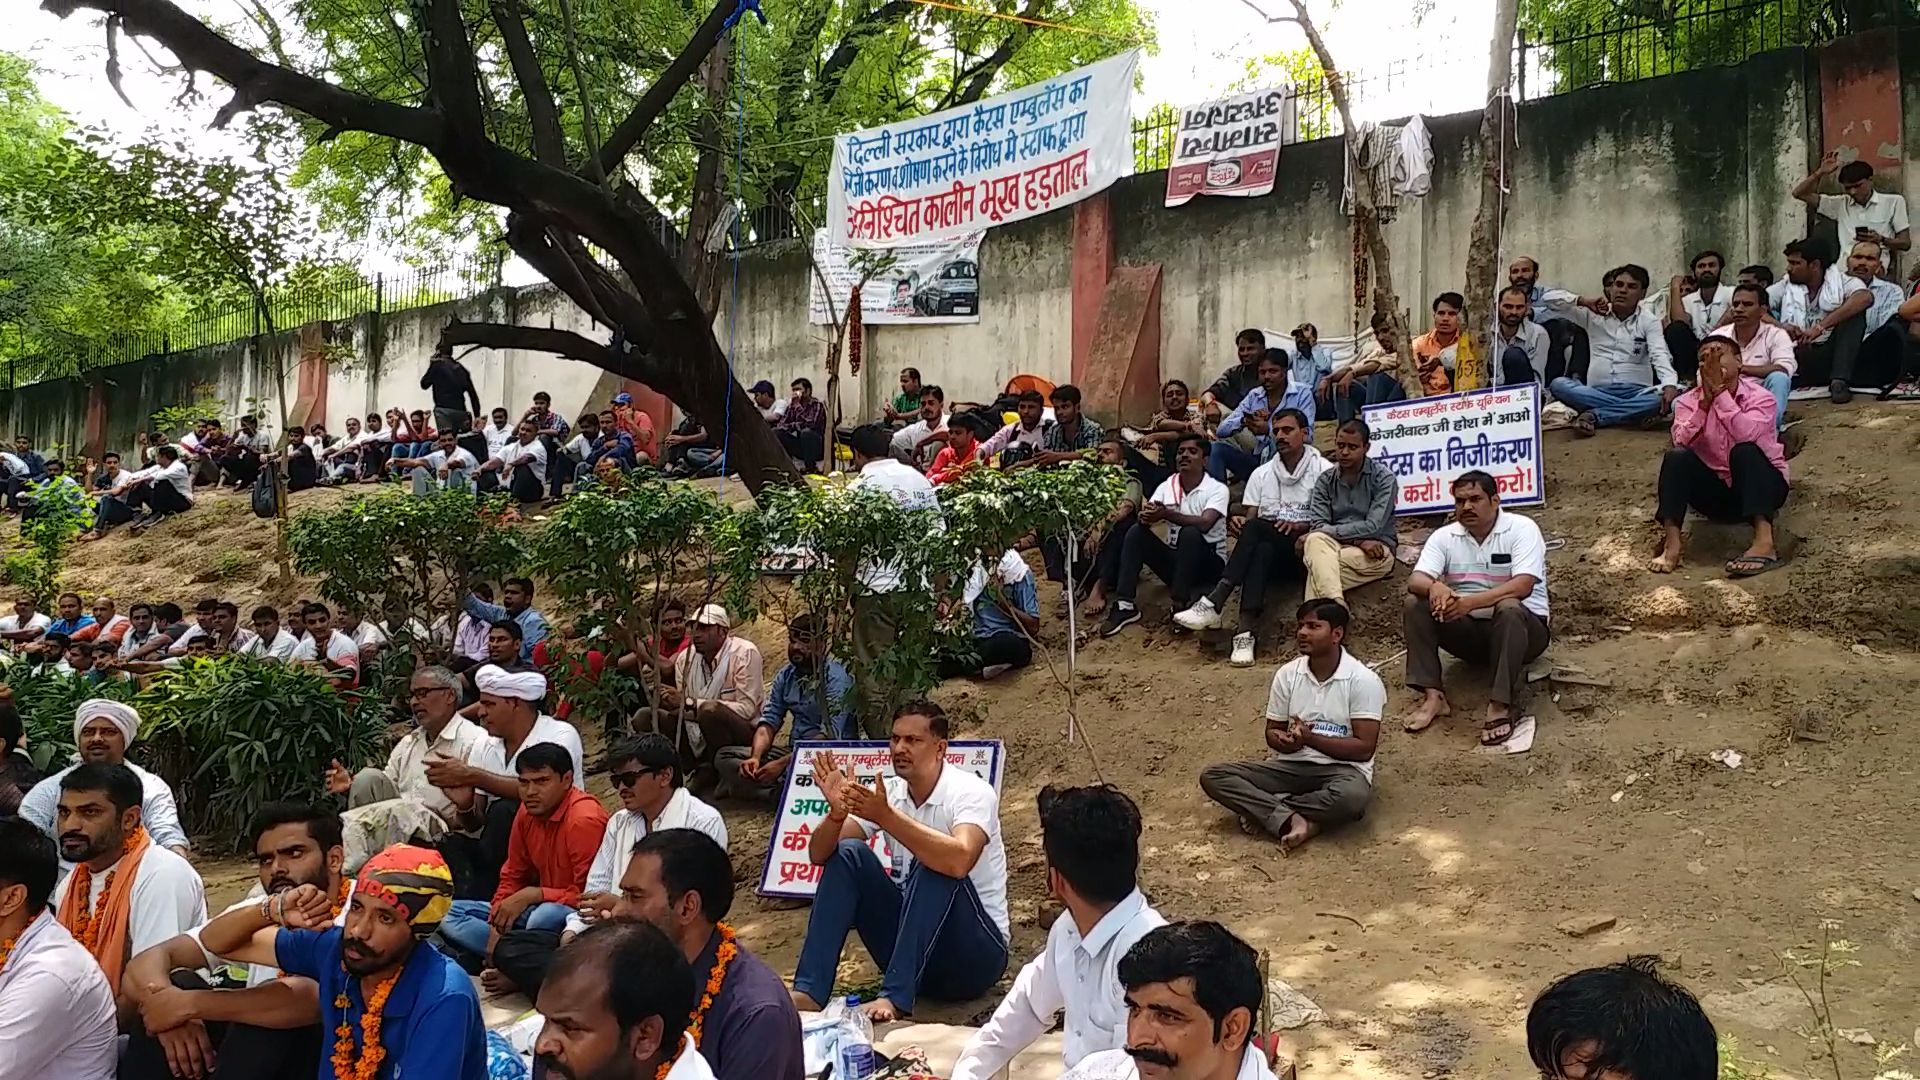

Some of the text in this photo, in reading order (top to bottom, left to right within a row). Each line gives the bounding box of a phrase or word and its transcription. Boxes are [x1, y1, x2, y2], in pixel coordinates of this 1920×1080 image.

[847, 129, 892, 165] दिल्ली
[893, 124, 941, 155] सरकार
[942, 115, 971, 148] द्वारा
[1069, 75, 1092, 105] का
[899, 157, 931, 190] शोषण
[933, 151, 957, 183] करने
[958, 145, 968, 176] के
[970, 138, 1003, 173] विरोध
[1058, 110, 1087, 153] द्वारा
[847, 148, 1090, 239] अनिश्चित कालीन भूख हड़ताल
[1477, 394, 1511, 410] यूनियन
[1369, 424, 1430, 441] केजरीवाल
[1432, 417, 1450, 432] जी
[1453, 415, 1479, 431] होश
[1497, 407, 1531, 425] आओ
[1418, 449, 1442, 473] का
[1446, 432, 1533, 470] निजीकरण
[1403, 476, 1440, 504] करो!
